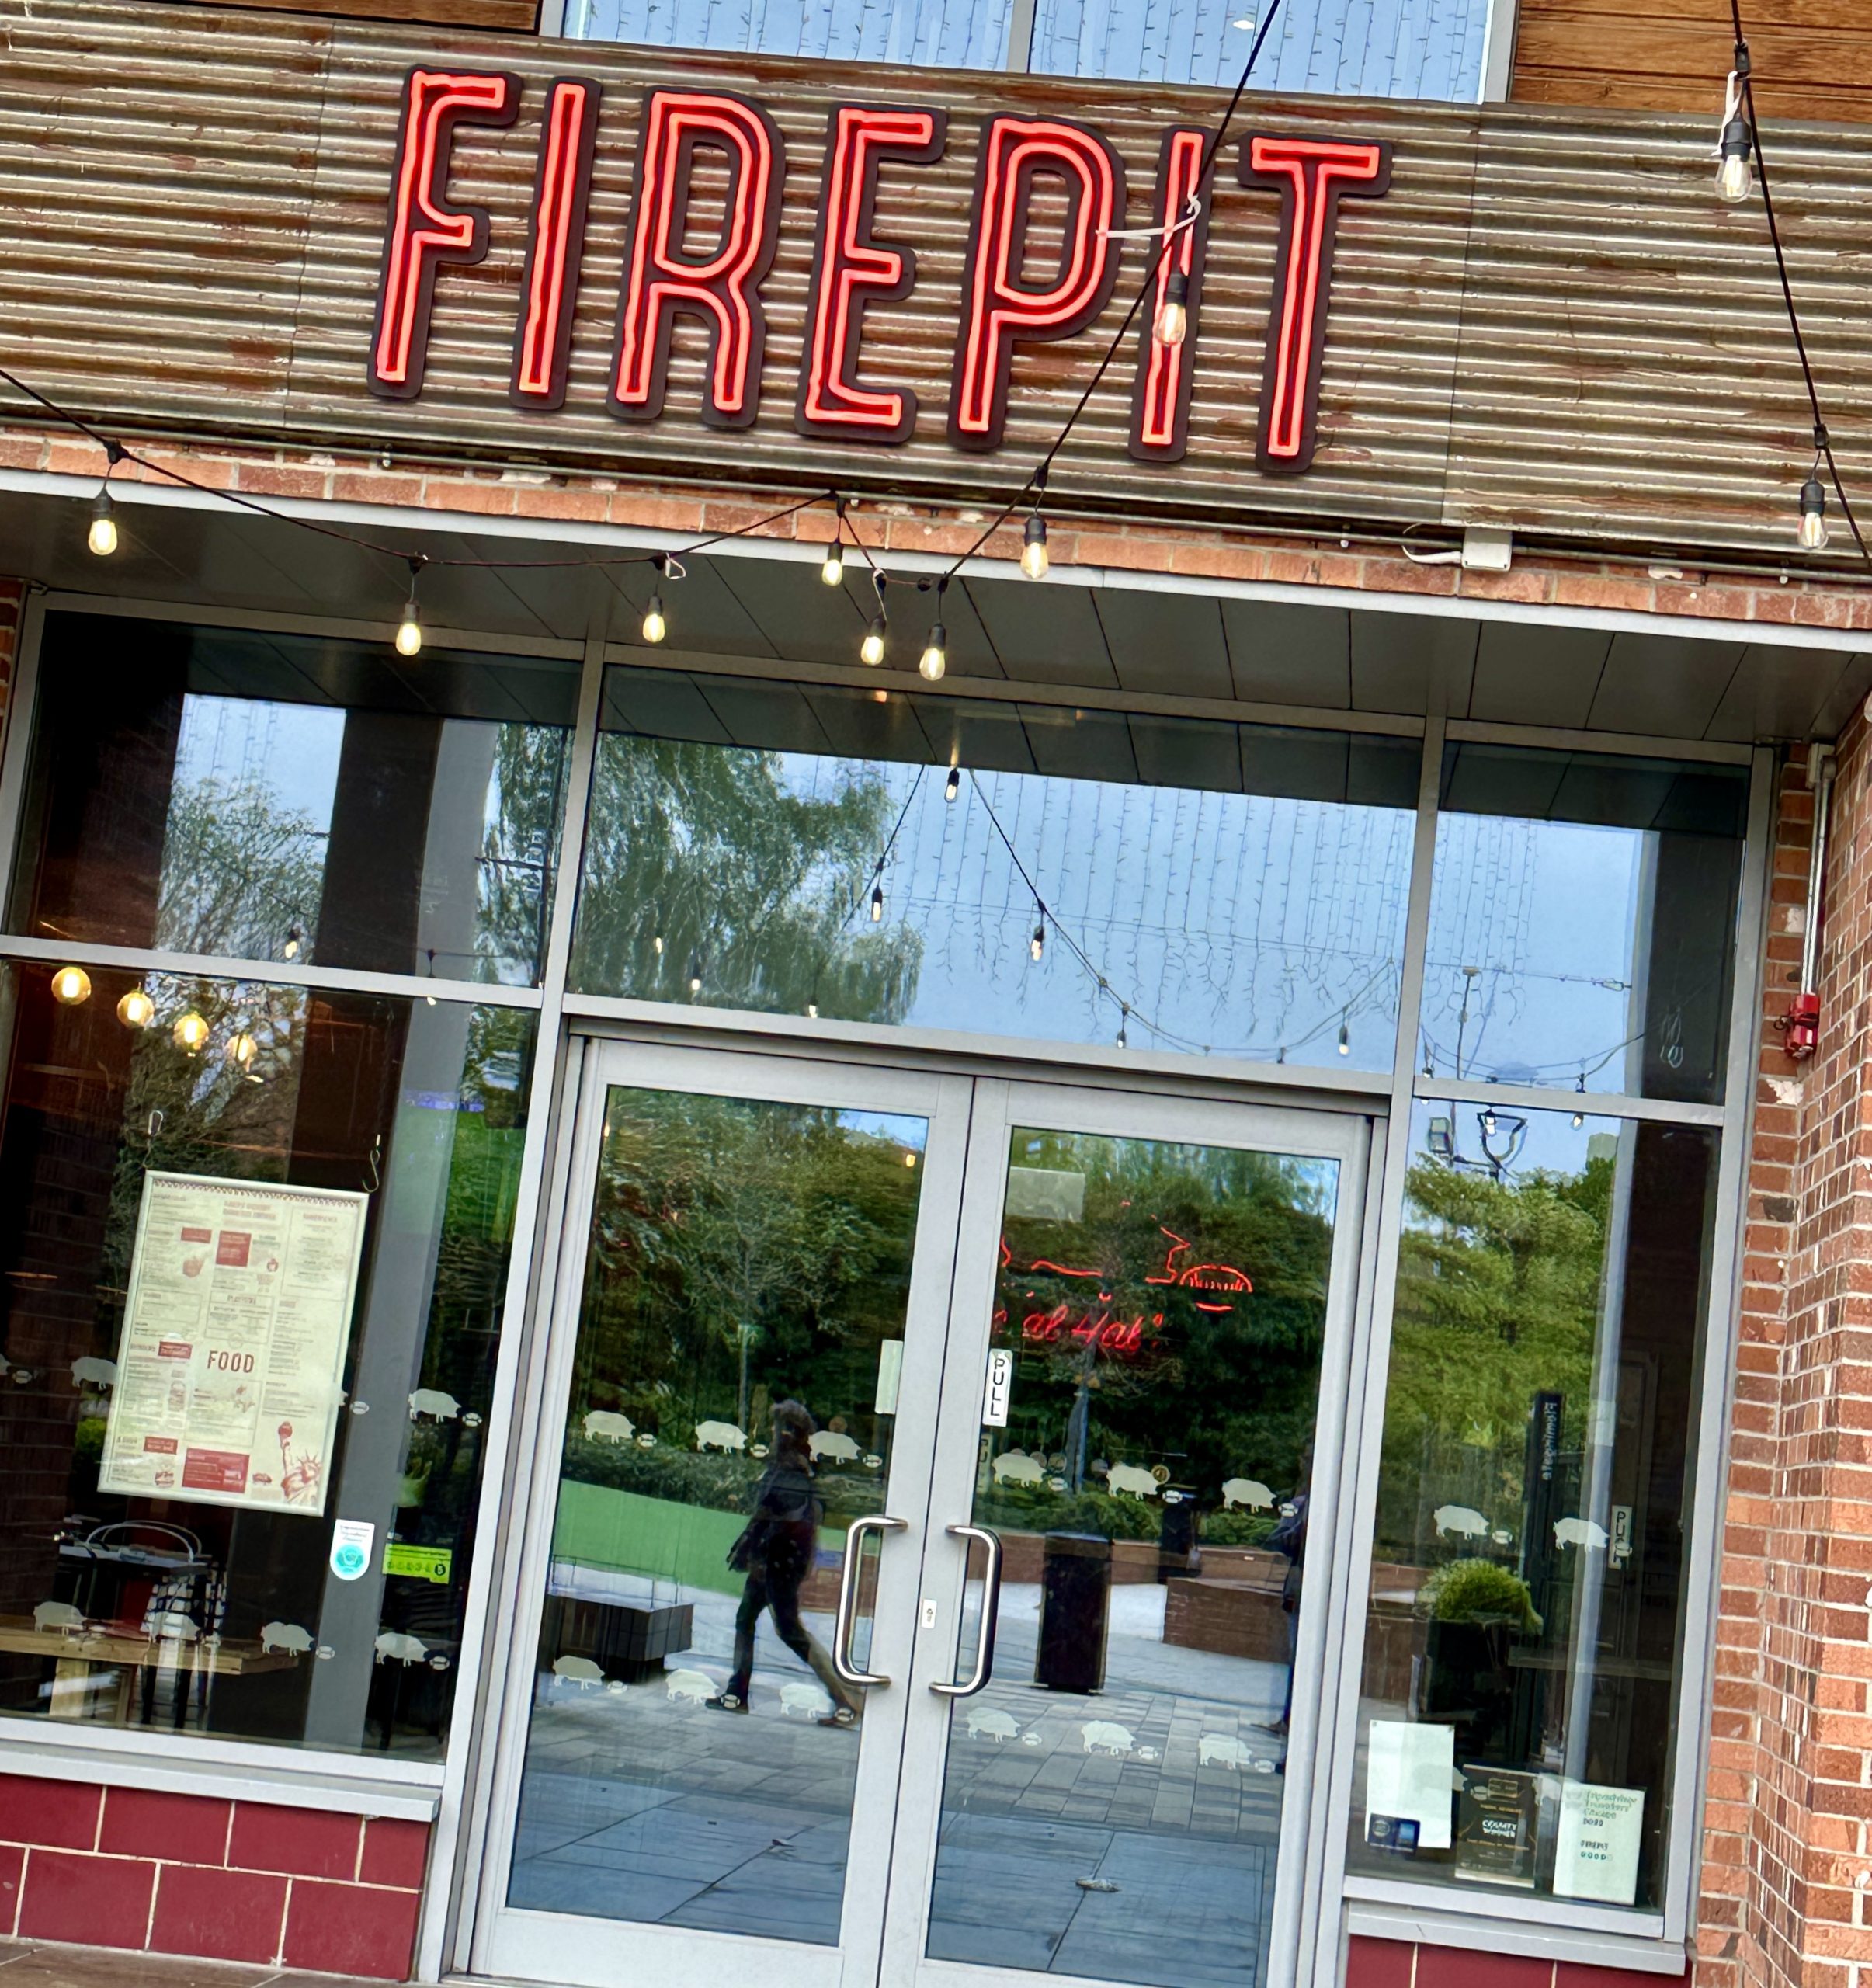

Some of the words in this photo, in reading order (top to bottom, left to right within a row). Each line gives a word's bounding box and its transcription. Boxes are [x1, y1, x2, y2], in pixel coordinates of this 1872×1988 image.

[371, 67, 1384, 464] FIREPIT
[207, 1350, 255, 1375] FOOD
[990, 1357, 1005, 1416] PULL
